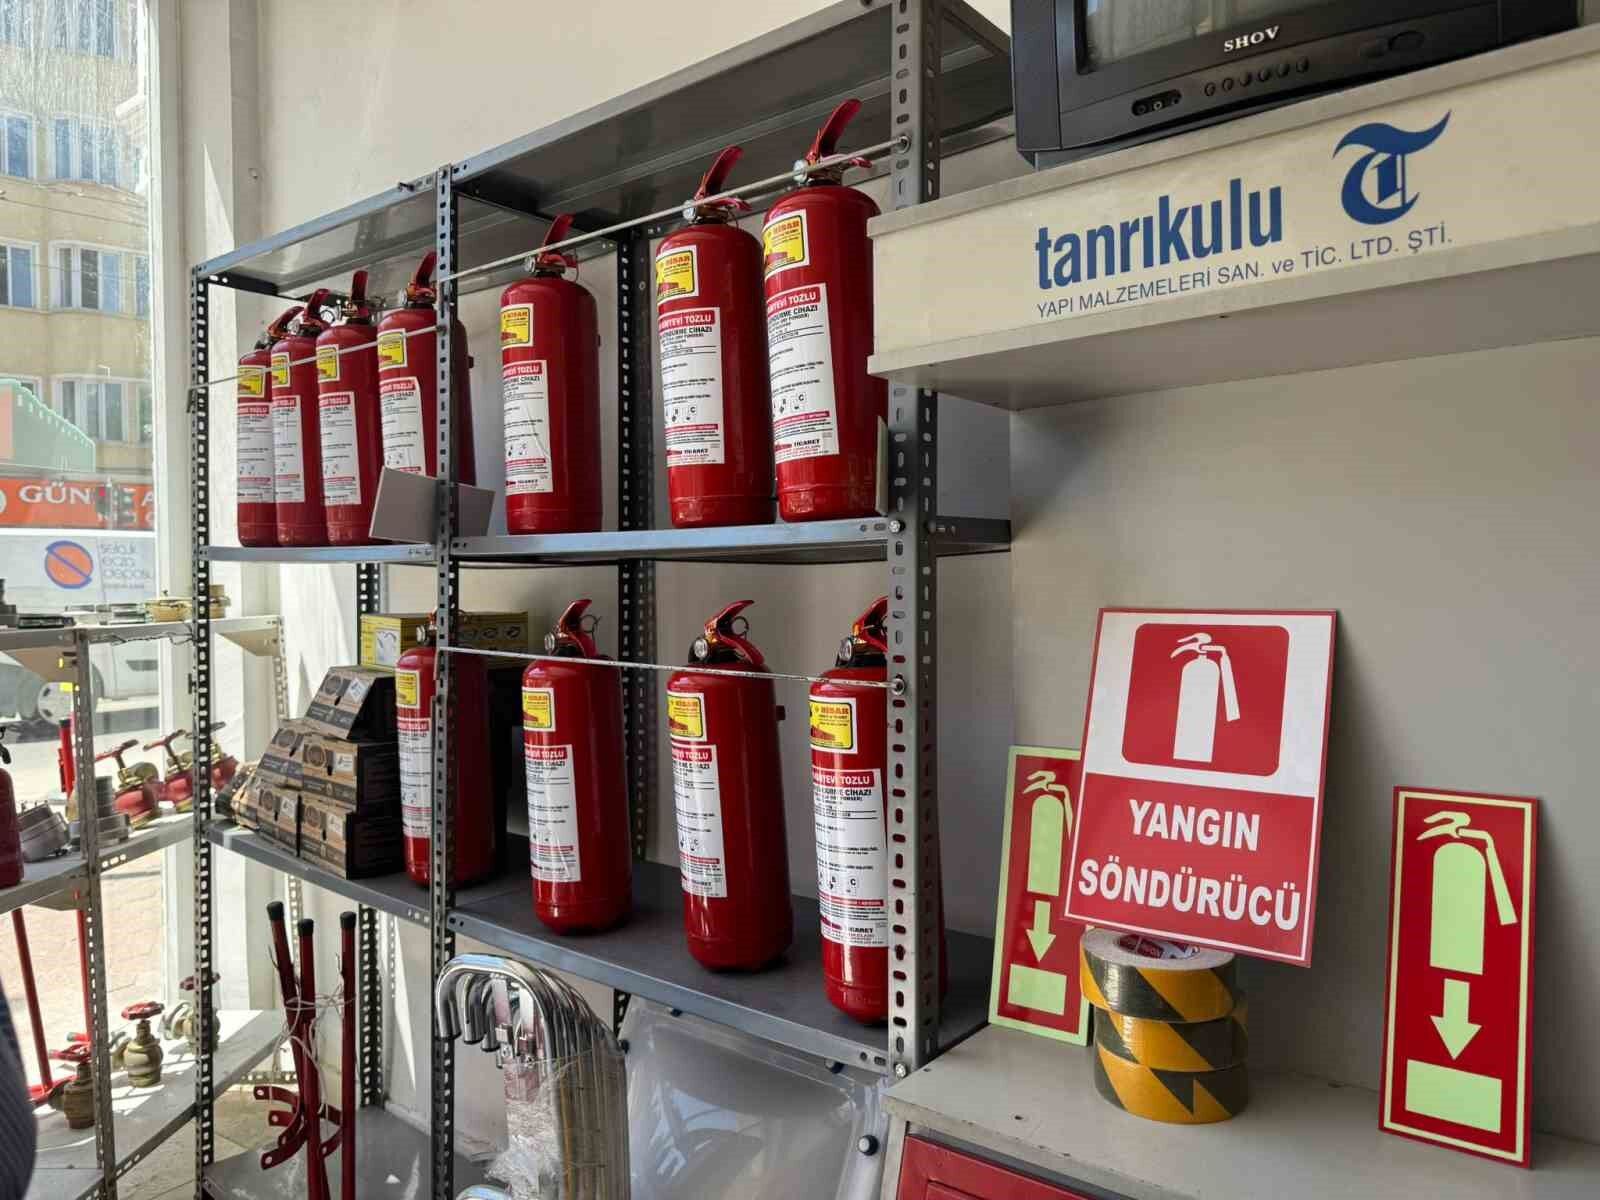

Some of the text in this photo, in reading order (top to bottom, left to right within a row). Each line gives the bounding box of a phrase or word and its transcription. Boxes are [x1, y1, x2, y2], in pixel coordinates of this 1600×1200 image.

[1223, 25, 1280, 52] SHOV
[1036, 177, 1282, 291] tanrıkulu
[1037, 219, 1454, 319] YAPI MALZEMELERİ SAN. ve TİC. LTD. ŞTİ.
[788, 291, 816, 305] TOZLU
[685, 313, 712, 324] TOZLU
[841, 775, 871, 785] TOZLU
[1129, 799, 1260, 851] YANGIN
[850, 878, 857, 886] C
[1078, 855, 1301, 931] SÖNDÜRÜCÜ
